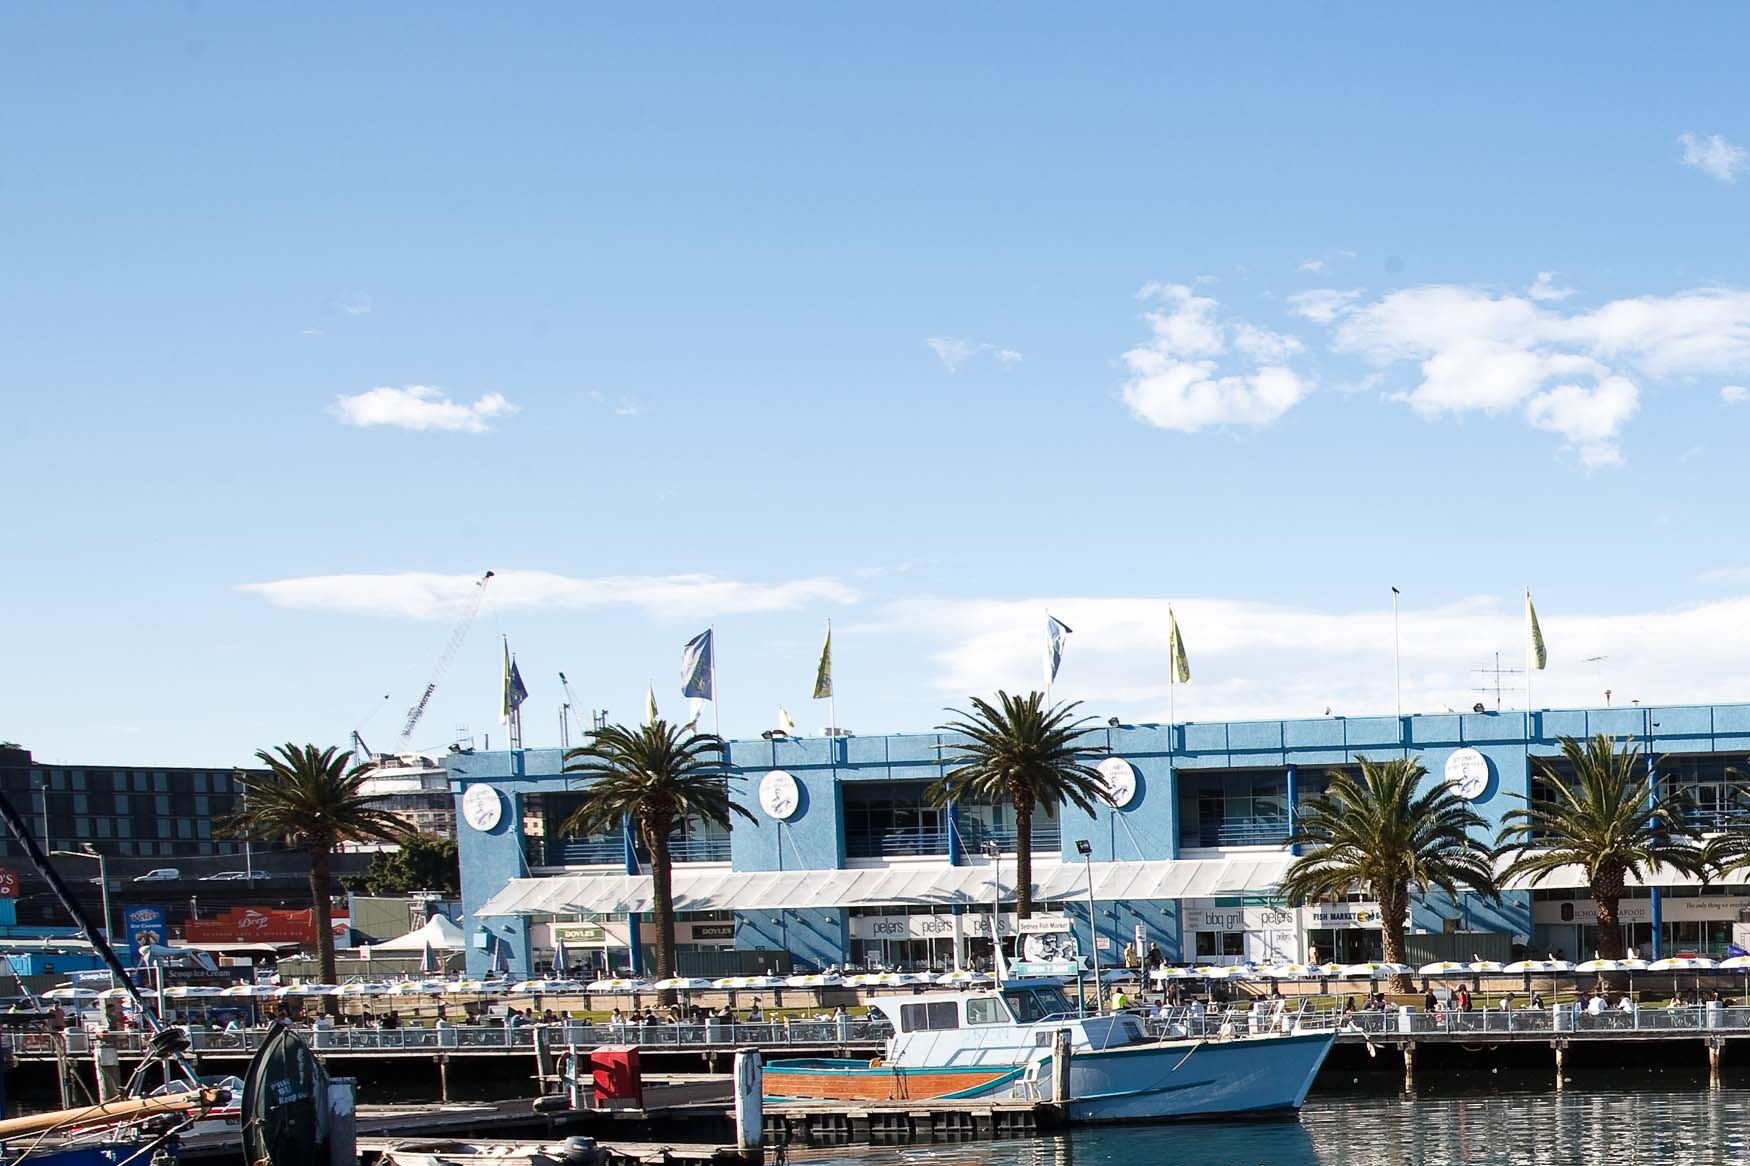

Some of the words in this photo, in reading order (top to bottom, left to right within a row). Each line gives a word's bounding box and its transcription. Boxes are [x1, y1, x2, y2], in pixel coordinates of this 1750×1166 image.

[1205, 911, 1224, 927] bbq
[1226, 911, 1244, 930] grill
[1261, 909, 1293, 928] peters
[1313, 912, 1328, 921] FISH
[1330, 912, 1356, 921] MARKET
[564, 930, 595, 938] DOYLES
[873, 917, 904, 937] peters
[921, 917, 953, 937] peters
[206, 969, 231, 978] Cream
[279, 1094, 297, 1105] Keep
